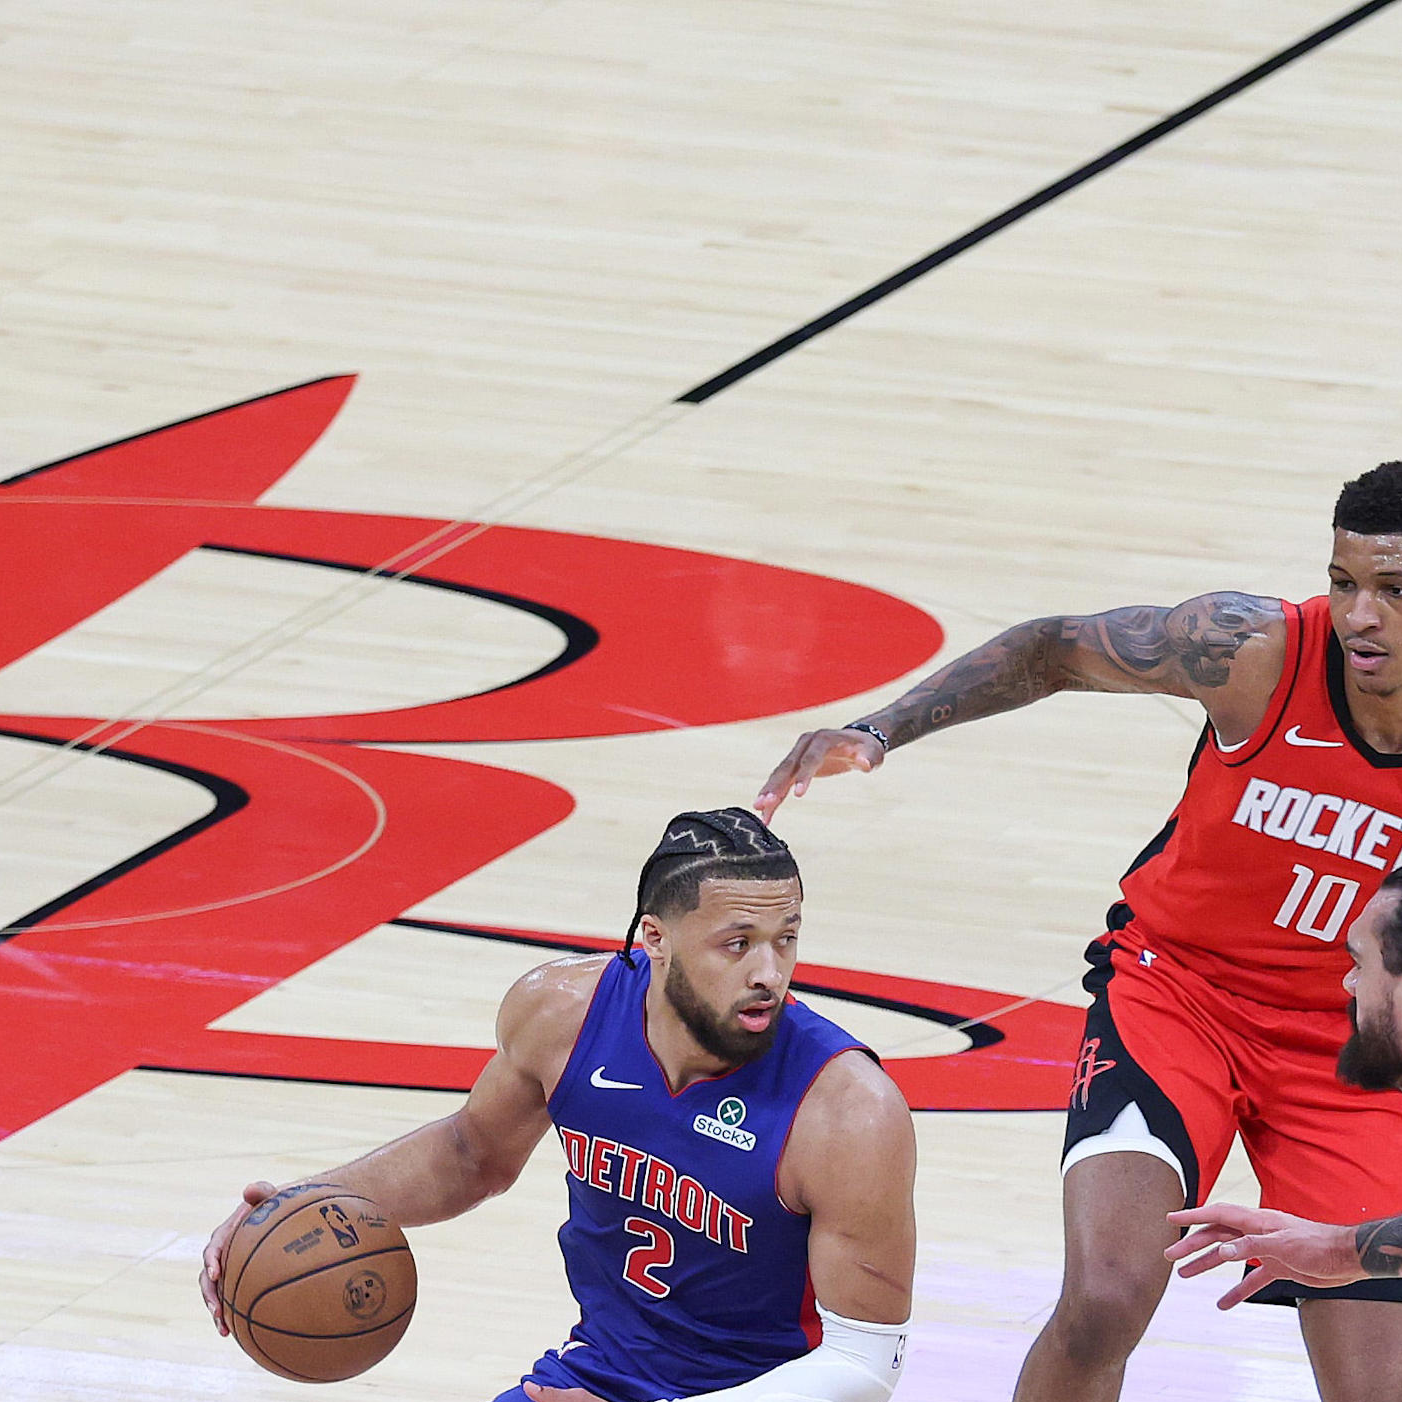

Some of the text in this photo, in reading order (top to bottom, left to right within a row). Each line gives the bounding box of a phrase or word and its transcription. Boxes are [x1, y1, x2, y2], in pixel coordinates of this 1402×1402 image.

[1273, 863, 1361, 943] 10
[696, 1117, 754, 1148] StockX
[559, 1125, 754, 1254] DETROIT
[622, 1216, 675, 1299] 2
